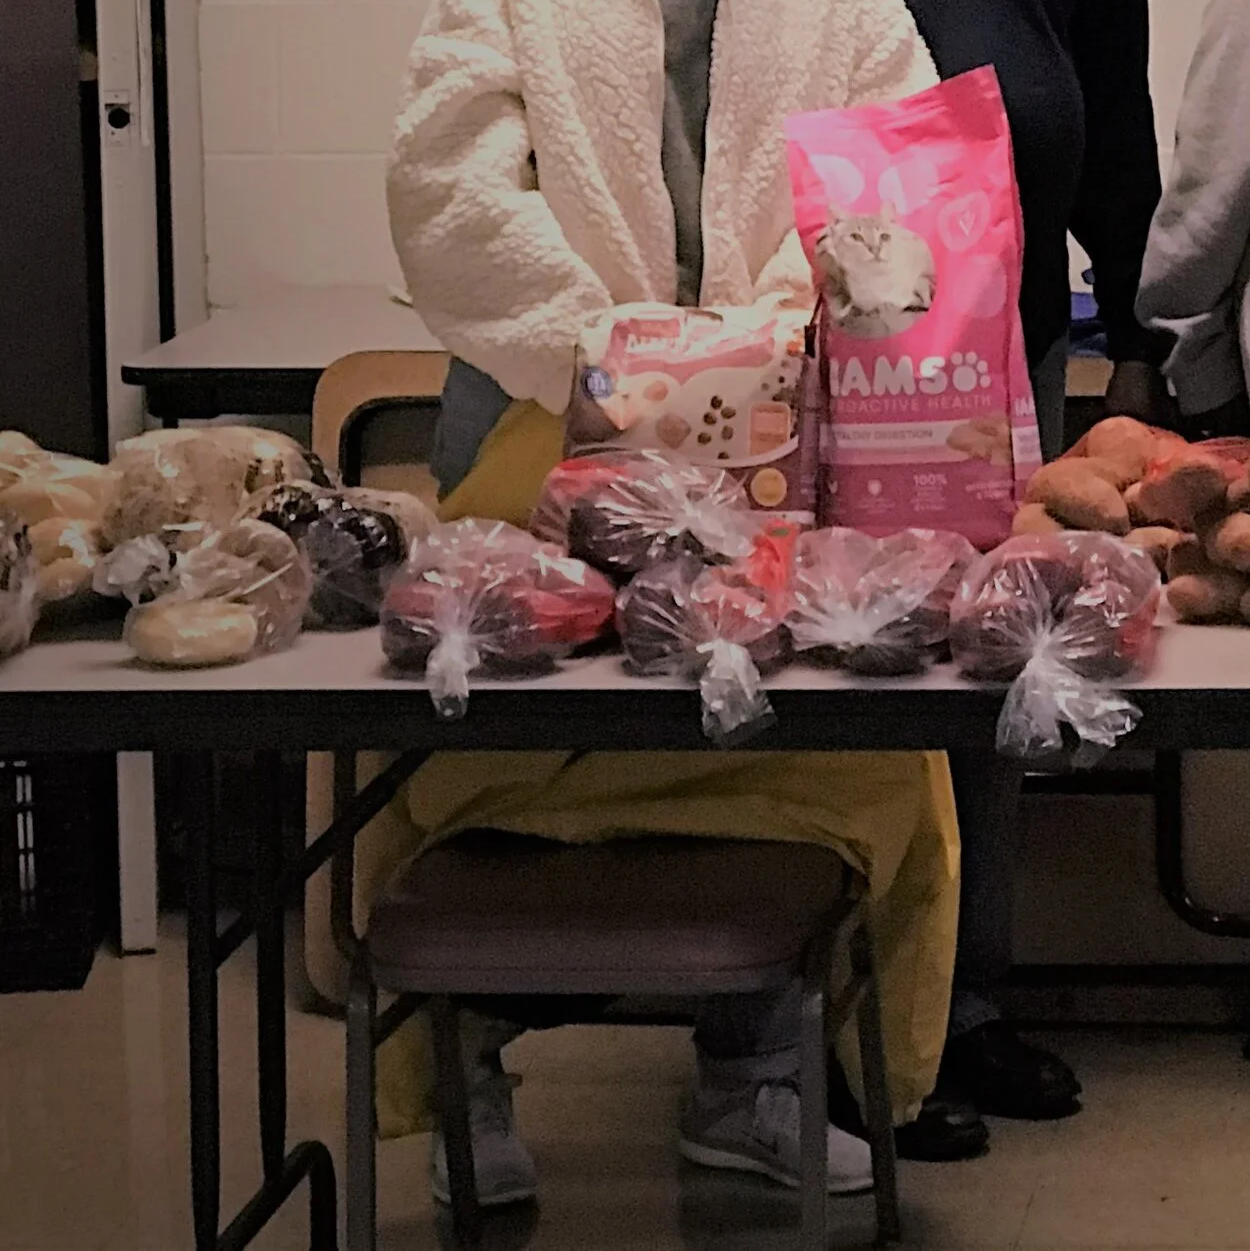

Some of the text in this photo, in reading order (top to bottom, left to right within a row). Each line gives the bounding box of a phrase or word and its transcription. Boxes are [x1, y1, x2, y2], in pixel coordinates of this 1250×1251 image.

[829, 354, 948, 397] IAMS
[831, 395, 992, 413] ROACTIVE HEALTH
